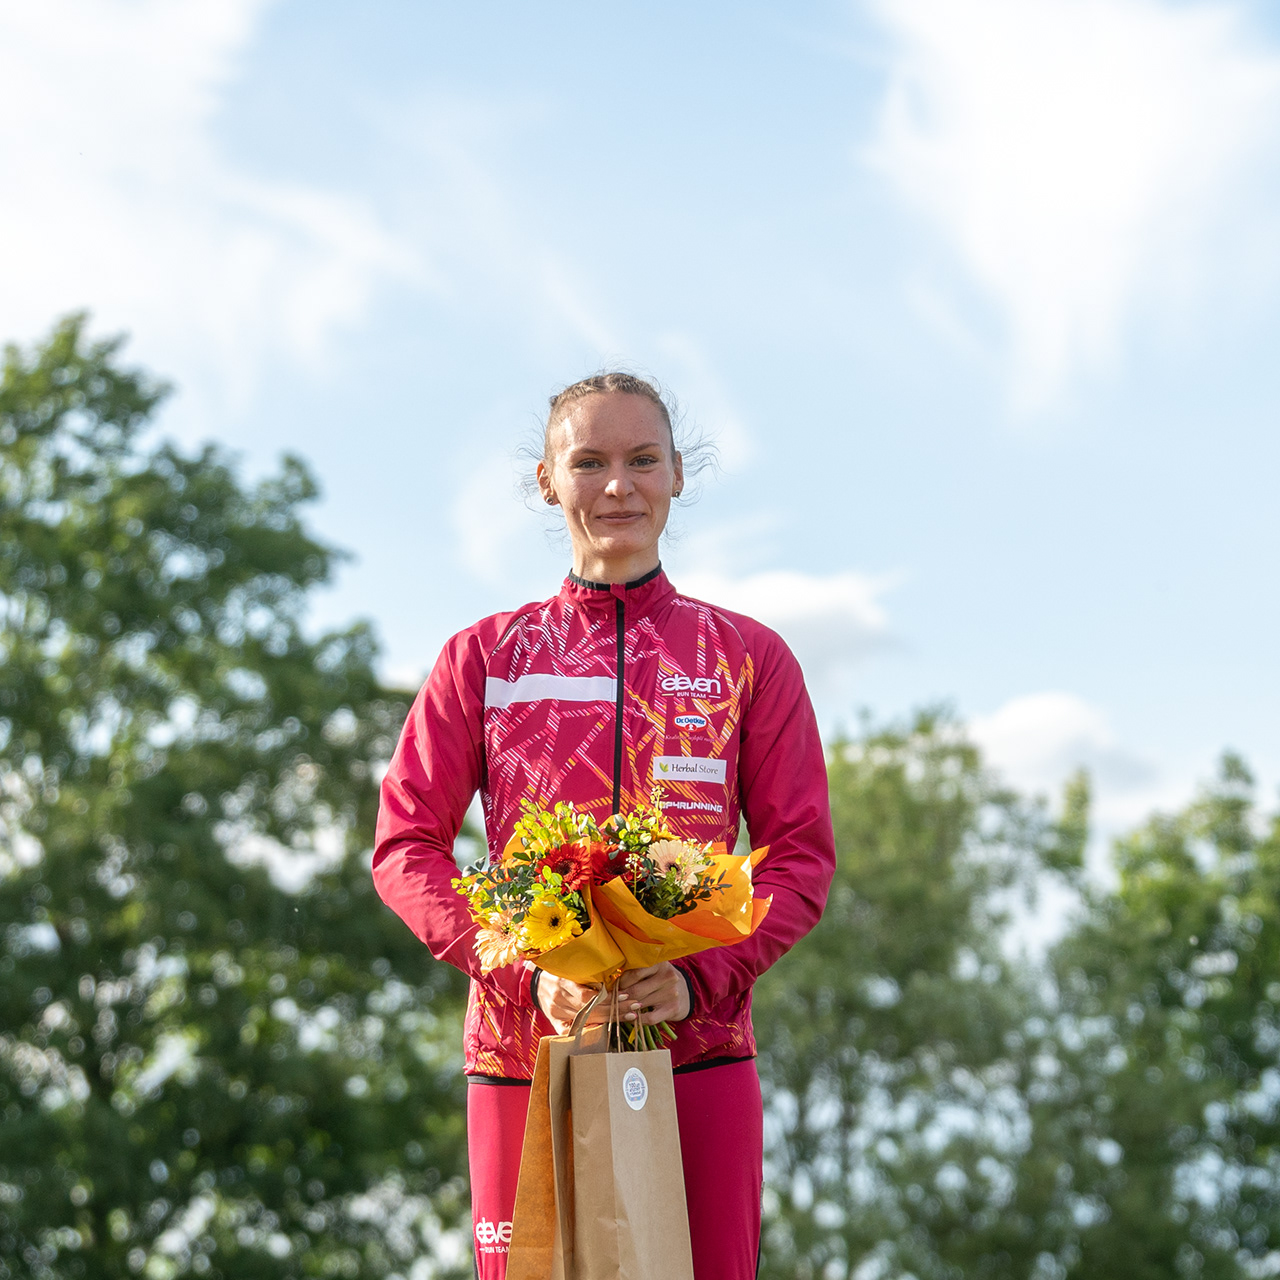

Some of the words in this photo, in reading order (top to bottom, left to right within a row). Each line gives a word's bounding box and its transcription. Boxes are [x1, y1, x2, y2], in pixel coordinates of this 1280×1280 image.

[661, 674, 721, 694] eleven
[672, 764, 697, 773] Herbal
[699, 765, 718, 774] Store
[476, 1217, 512, 1243] eleve
